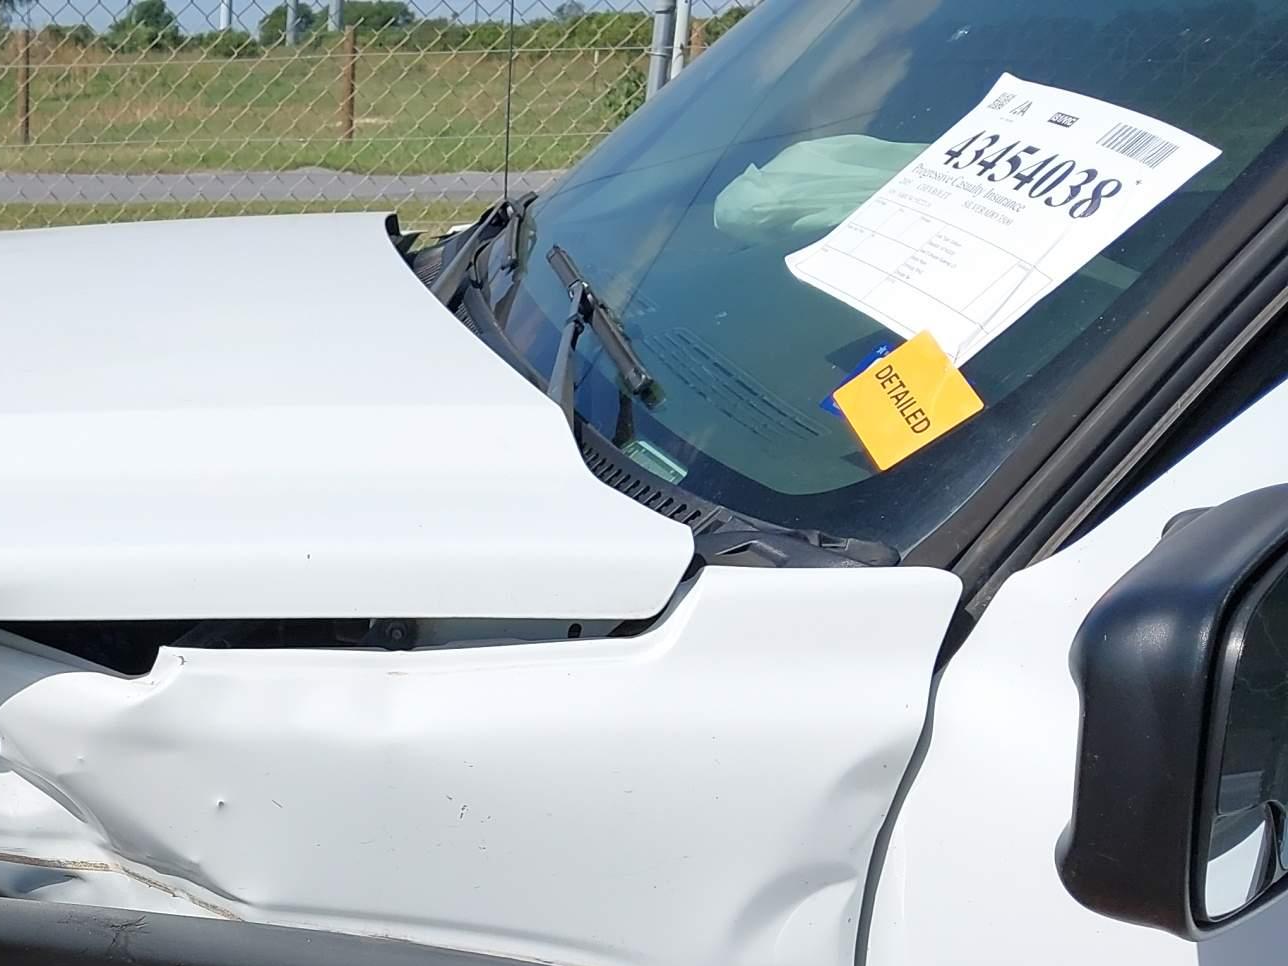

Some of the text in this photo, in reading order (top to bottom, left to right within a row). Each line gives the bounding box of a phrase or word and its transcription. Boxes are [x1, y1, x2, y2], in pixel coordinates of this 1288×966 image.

[943, 130, 1122, 219] 43454038
[983, 187, 1026, 213] Insurance
[874, 364, 931, 434] DETAILED
